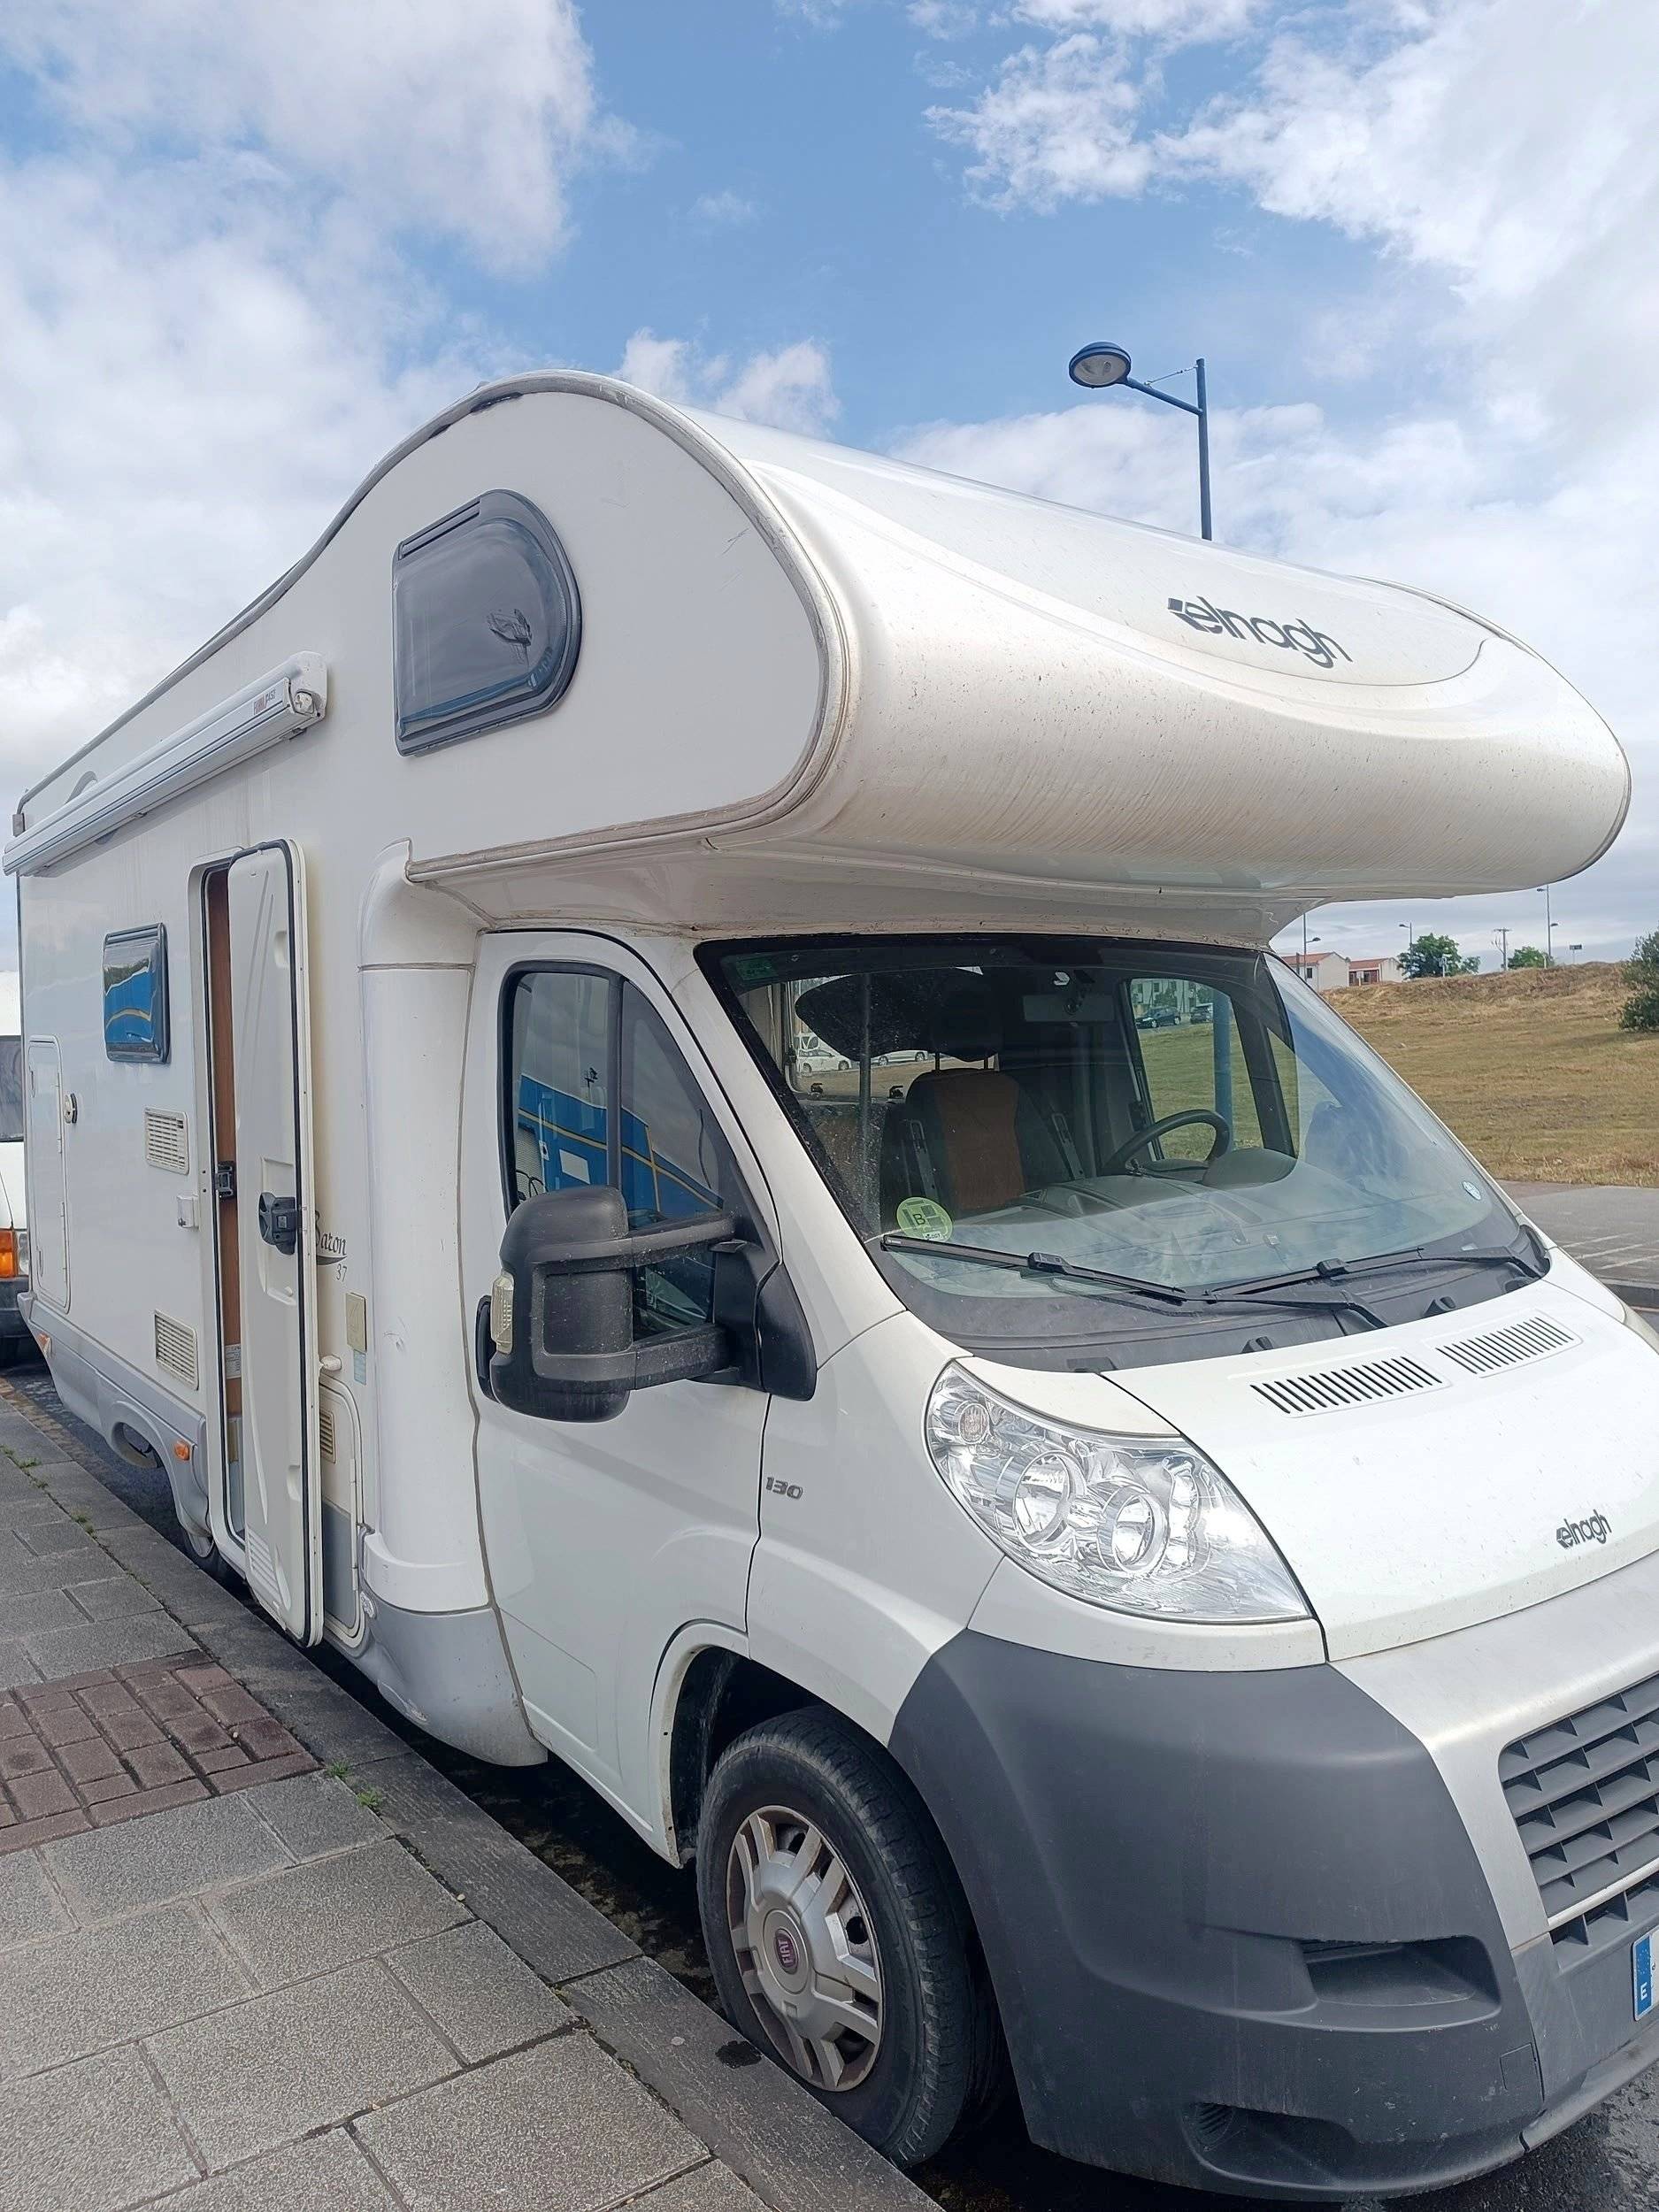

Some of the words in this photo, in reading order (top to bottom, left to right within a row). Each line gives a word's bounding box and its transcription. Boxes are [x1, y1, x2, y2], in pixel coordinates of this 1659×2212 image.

[1168, 595, 1353, 669] elnagh
[912, 1213, 926, 1225] B
[336, 1263, 348, 1282] 37
[765, 1477, 803, 1500] 130
[1556, 1509, 1612, 1550] elnagh
[779, 1939, 795, 1969] FIAT
[1640, 1981, 1648, 2001] E
